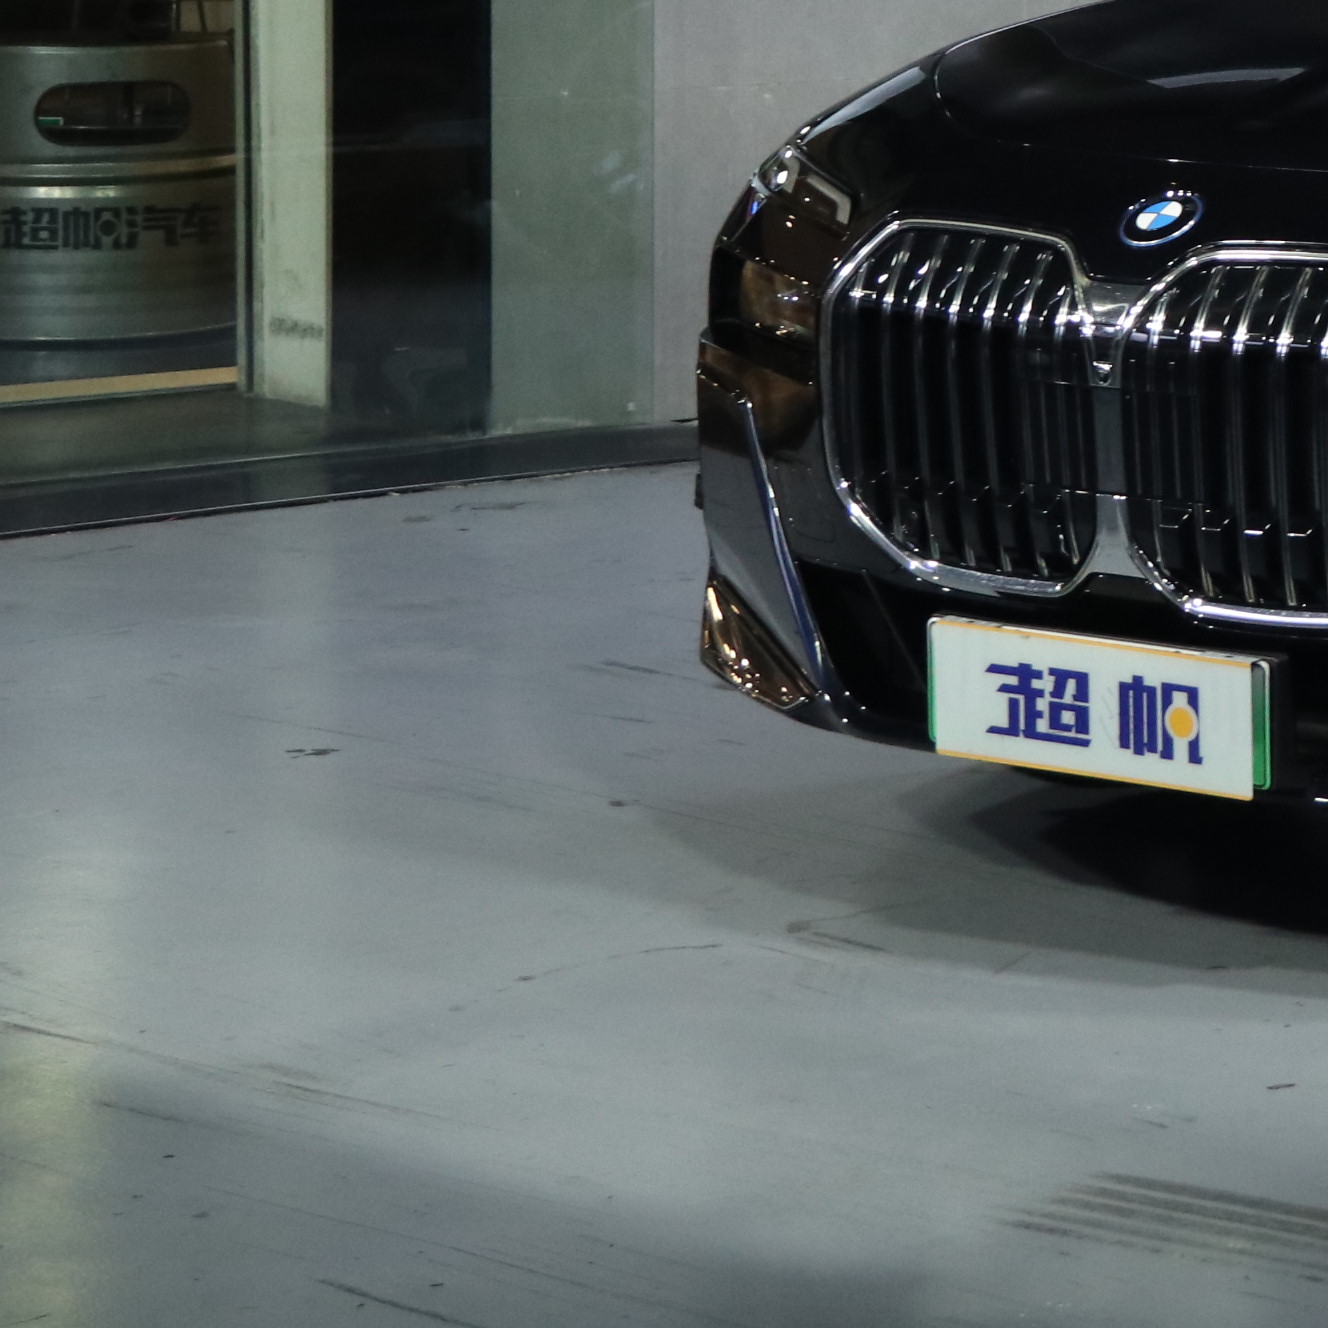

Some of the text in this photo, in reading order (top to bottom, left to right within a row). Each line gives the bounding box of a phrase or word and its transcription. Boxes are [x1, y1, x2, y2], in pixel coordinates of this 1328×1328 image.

[0, 201, 222, 250] 超帆汽车
[984, 661, 1204, 765] 超帆
